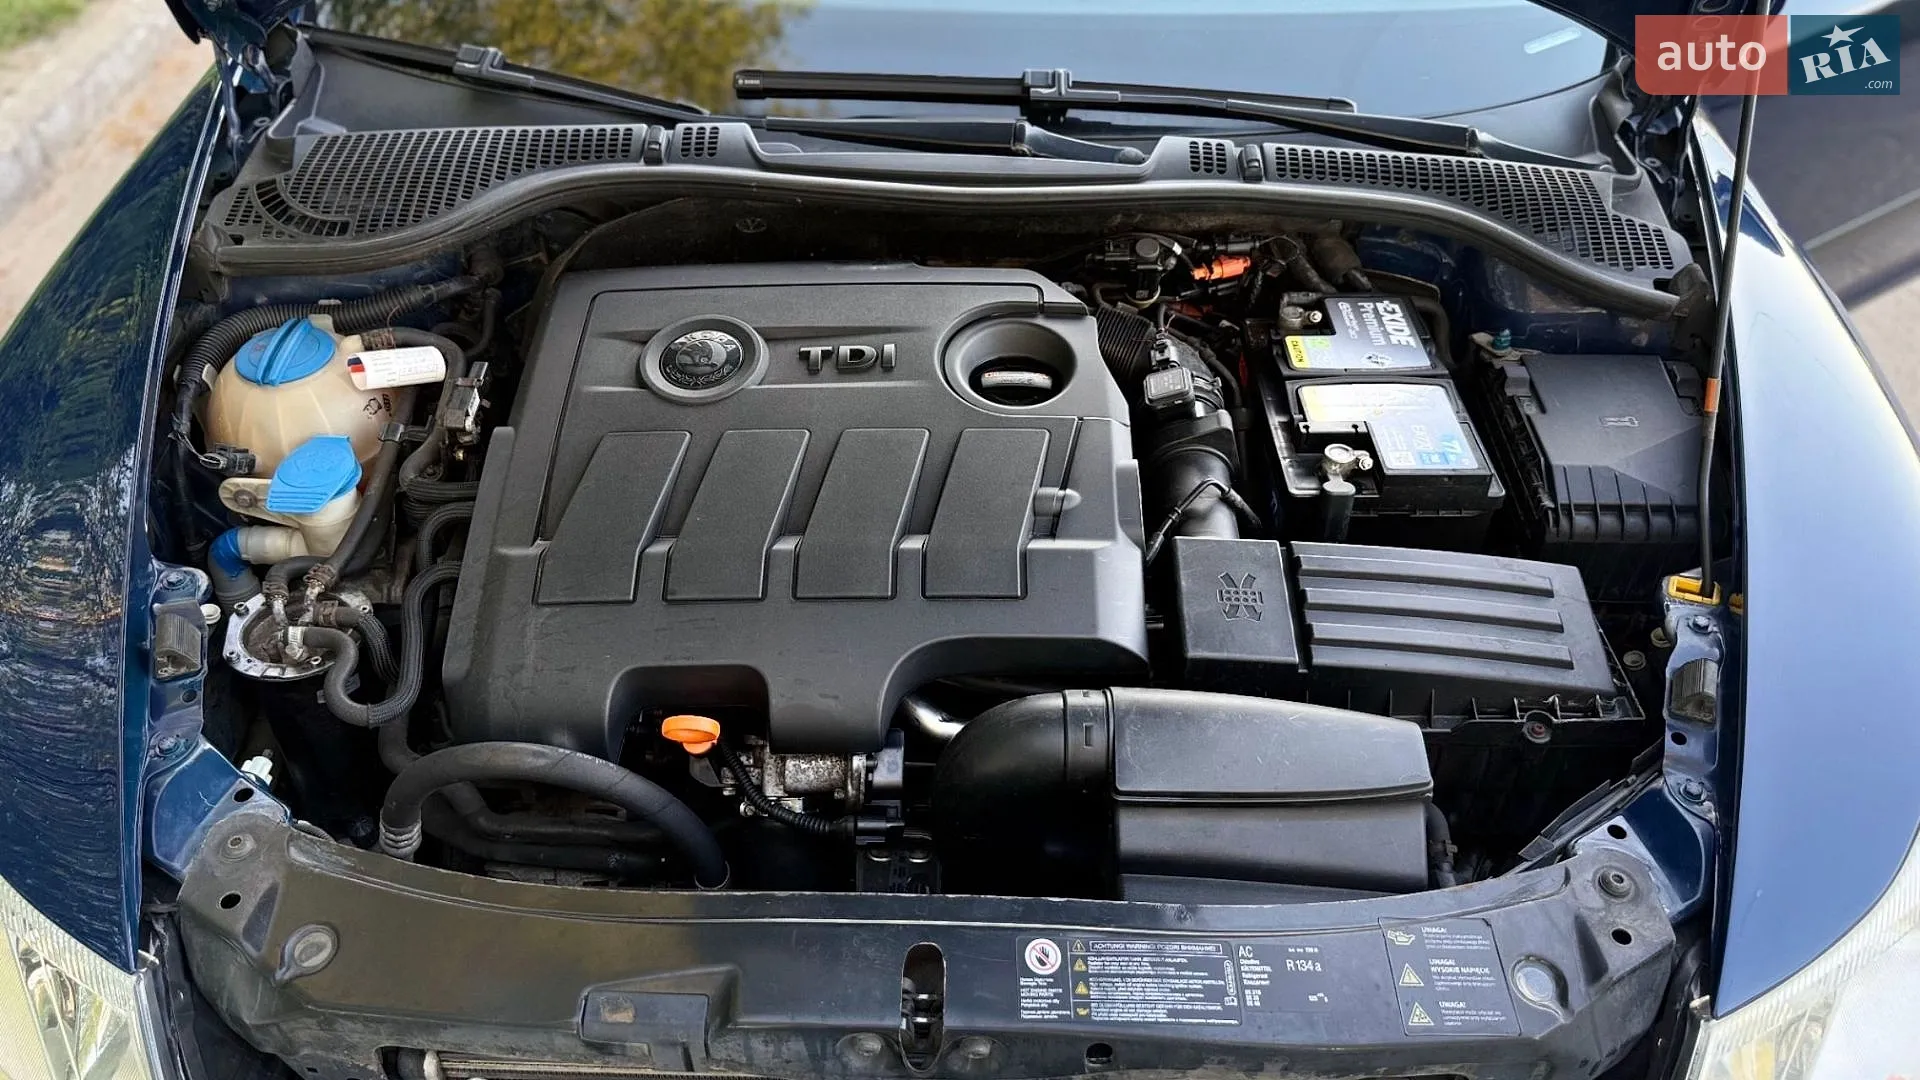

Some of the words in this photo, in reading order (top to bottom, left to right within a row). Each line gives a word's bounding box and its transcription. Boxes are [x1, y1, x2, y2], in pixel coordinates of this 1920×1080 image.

[1358, 302, 1386, 346] Premium
[1376, 300, 1417, 348] EXIDE
[799, 343, 898, 374] TDI
[1239, 945, 1253, 958] AC
